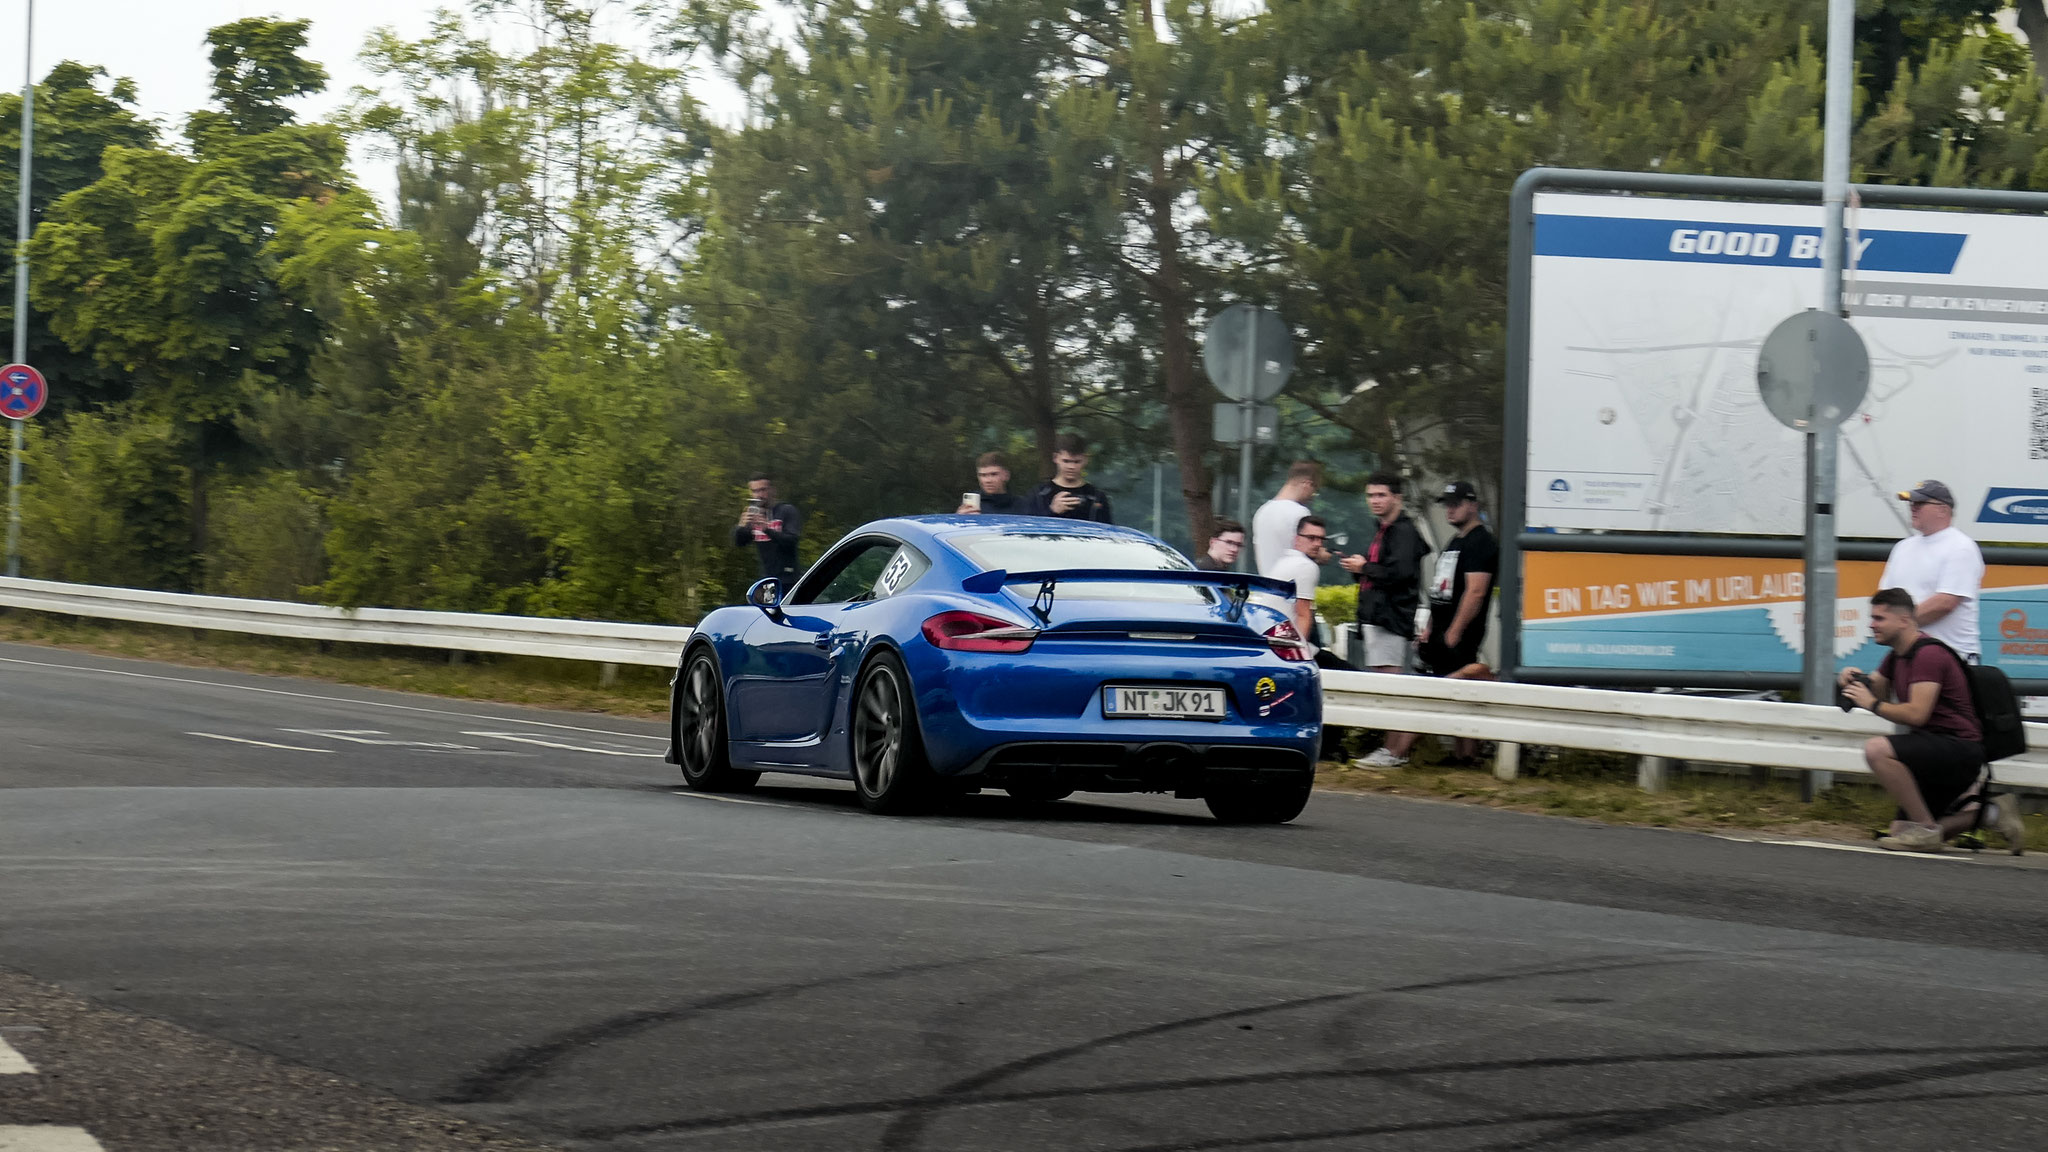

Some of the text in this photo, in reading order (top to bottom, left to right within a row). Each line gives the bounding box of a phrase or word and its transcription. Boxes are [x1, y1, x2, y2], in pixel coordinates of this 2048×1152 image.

[1669, 229, 1780, 258] GOOD
[1864, 293, 1907, 308] DER
[884, 554, 909, 592] 53
[1544, 571, 1805, 614] EIN TAG WIE IM URLAUB
[1124, 690, 1215, 713] NT JK 91
